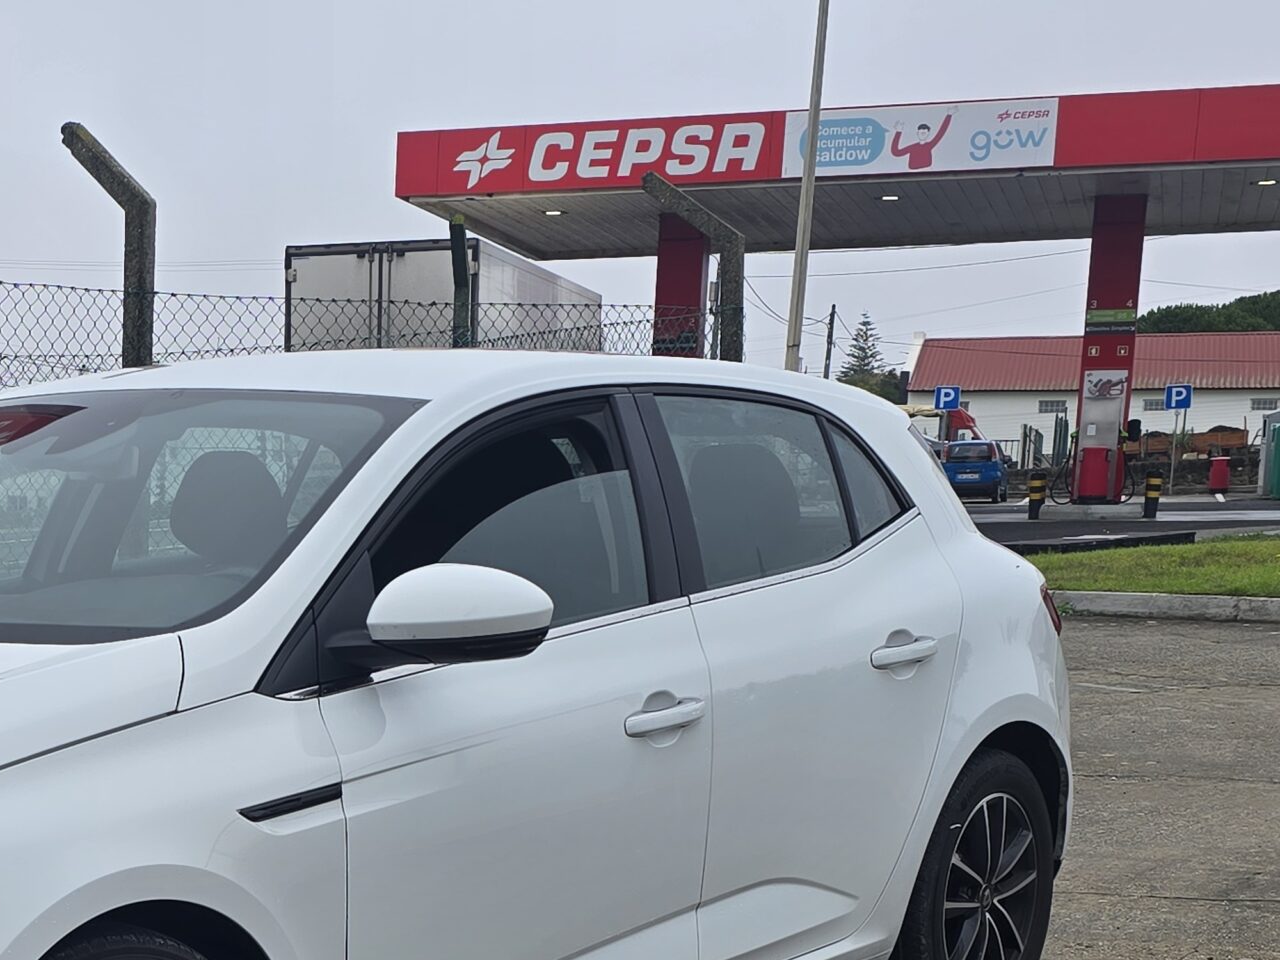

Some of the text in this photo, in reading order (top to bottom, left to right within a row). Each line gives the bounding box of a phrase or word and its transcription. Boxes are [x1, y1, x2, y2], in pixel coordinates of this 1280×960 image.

[1013, 109, 1050, 119] CEPSA
[865, 125, 873, 134] a
[528, 121, 766, 182] CEPSA
[939, 388, 955, 408] P
[1171, 386, 1187, 407] P
